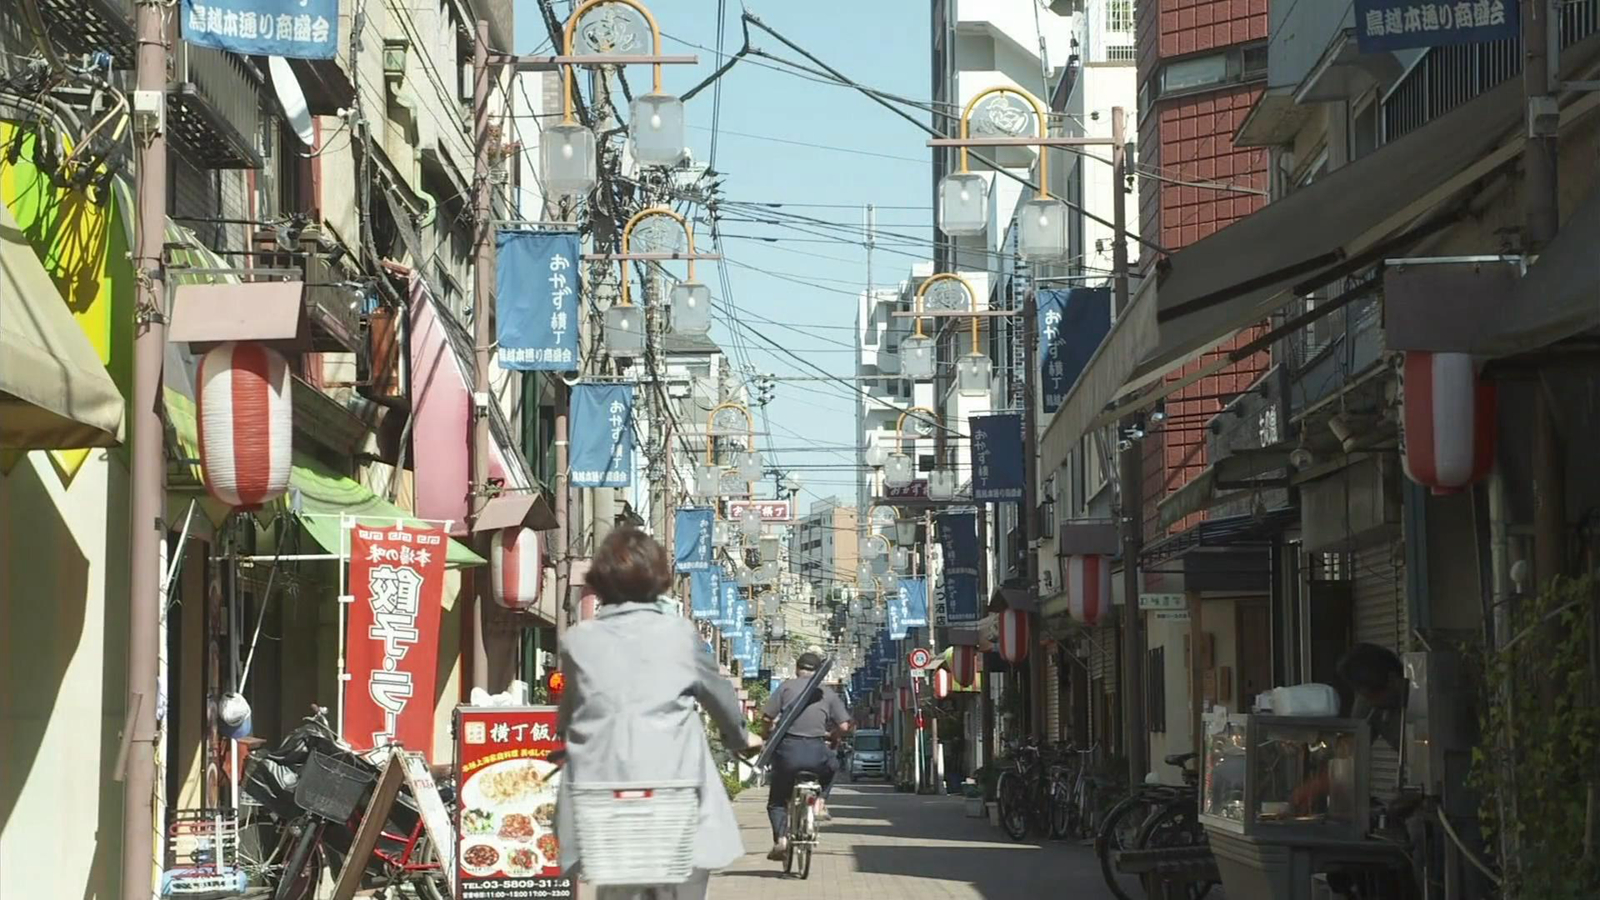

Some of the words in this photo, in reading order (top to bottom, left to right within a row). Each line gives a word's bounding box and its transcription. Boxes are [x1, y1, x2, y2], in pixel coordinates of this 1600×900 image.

[188, 6, 330, 43] 鳥越本通り商盛会
[1365, 0, 1505, 36] 鳥越本通り商盛会
[549, 253, 573, 345] おかず横丁
[1043, 309, 1067, 390] おかず横丁
[608, 400, 628, 469] おかず横丁
[974, 429, 991, 487] おかず横丁
[732, 505, 785, 517] お横丁
[489, 722, 561, 744] 横丁飯
